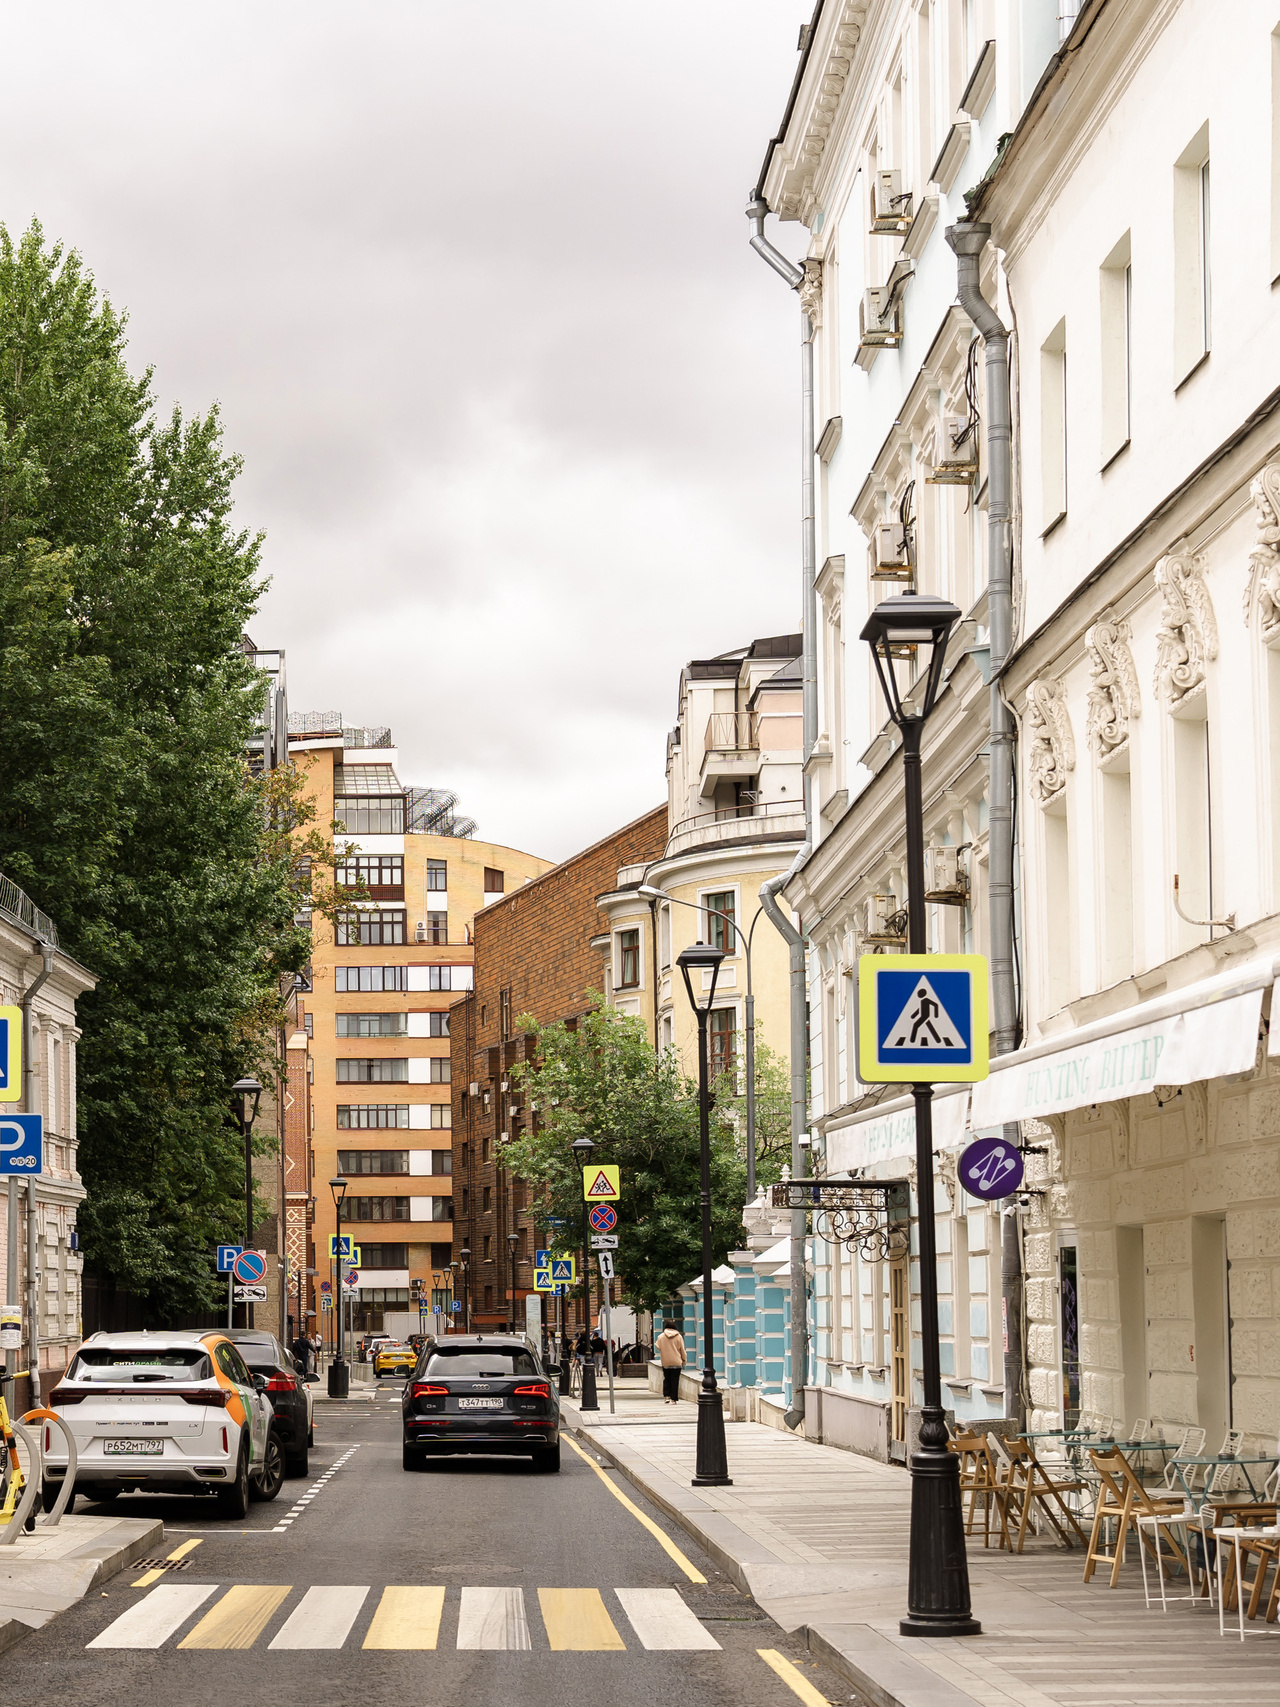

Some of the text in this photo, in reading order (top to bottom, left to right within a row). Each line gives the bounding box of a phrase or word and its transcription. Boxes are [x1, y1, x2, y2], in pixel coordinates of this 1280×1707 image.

[1024, 1056, 1091, 1107] HUNTING
[224, 1249, 238, 1269] P
[146, 1440, 161, 1448] 797
